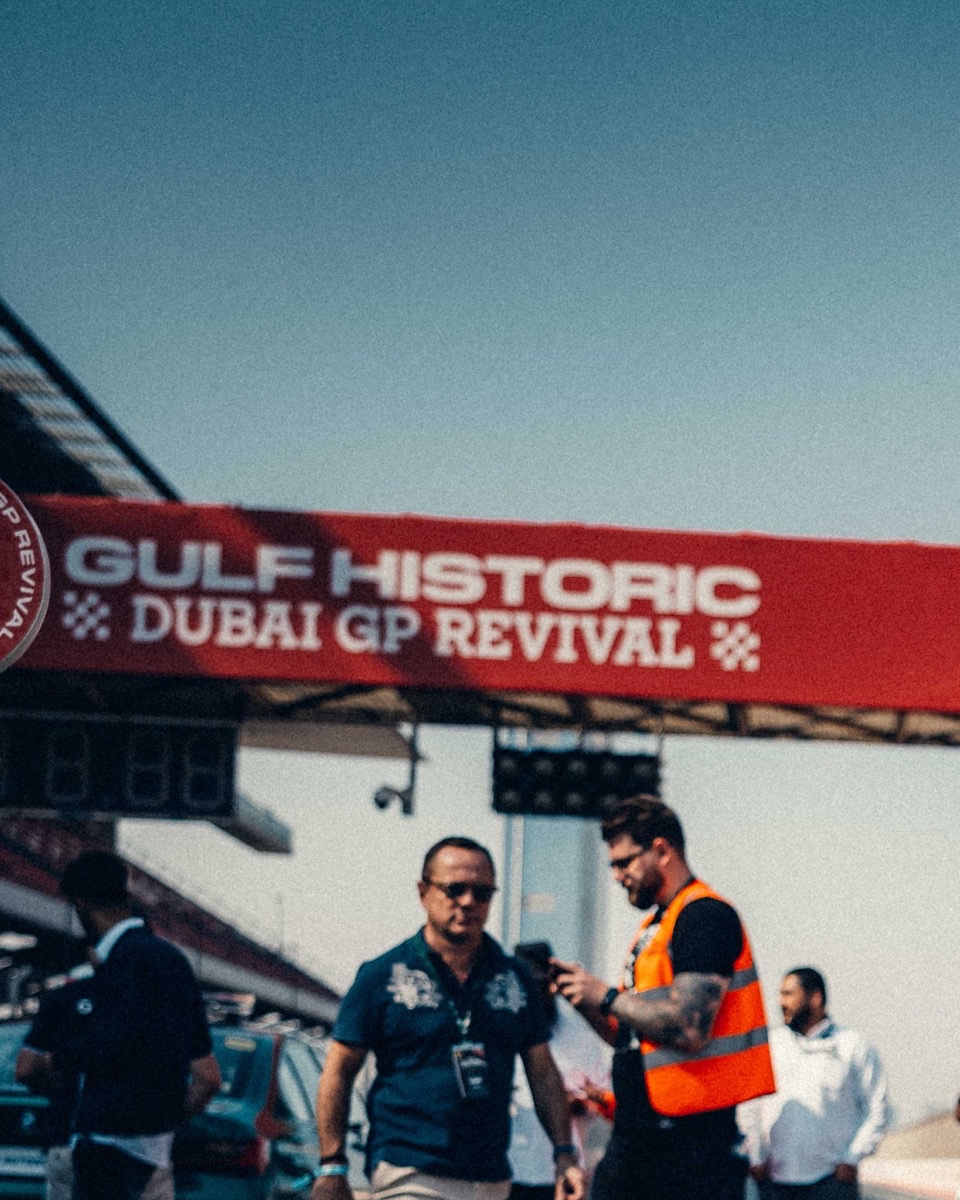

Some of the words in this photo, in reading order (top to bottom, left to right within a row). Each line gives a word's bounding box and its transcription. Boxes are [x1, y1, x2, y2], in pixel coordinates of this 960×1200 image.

[0, 529, 36, 639] REVIVAL
[65, 535, 314, 593] GULF
[330, 549, 763, 619] HISTORIC
[130, 593, 323, 650] DUBAI
[335, 604, 422, 655] GP
[433, 607, 696, 670] REVIVAL
